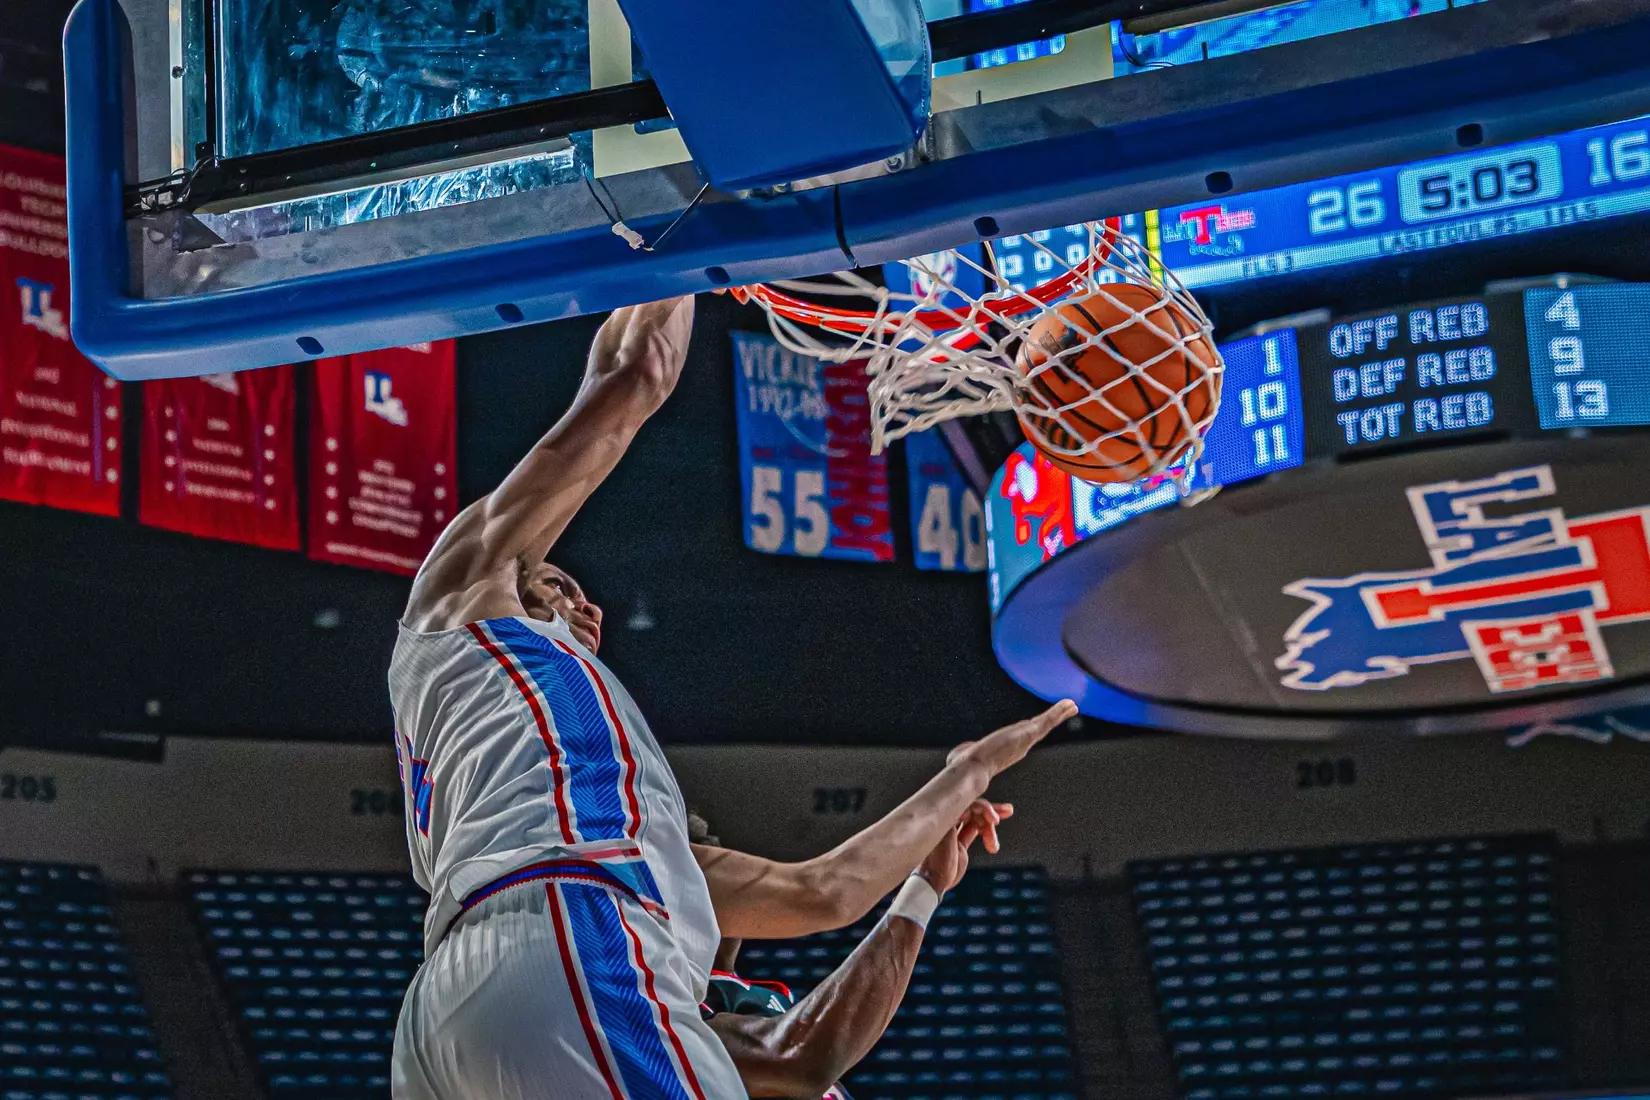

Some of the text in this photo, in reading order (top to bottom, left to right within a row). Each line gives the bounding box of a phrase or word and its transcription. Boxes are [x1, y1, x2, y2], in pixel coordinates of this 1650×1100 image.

[1308, 177, 1384, 235] 26
[1419, 159, 1538, 212] 5:03
[1587, 130, 1650, 187] 16
[1261, 337, 1283, 376] 1
[1329, 314, 1398, 358] OFF
[1545, 292, 1580, 330] 4
[1239, 380, 1288, 427] 10
[1332, 357, 1405, 402] DEF
[1546, 336, 1584, 376] 9
[1253, 423, 1289, 466] 11
[1337, 402, 1405, 444] TOT
[1552, 380, 1608, 421] 13
[752, 467, 828, 557] 55
[918, 485, 987, 572] 40
[812, 787, 868, 814] 207
